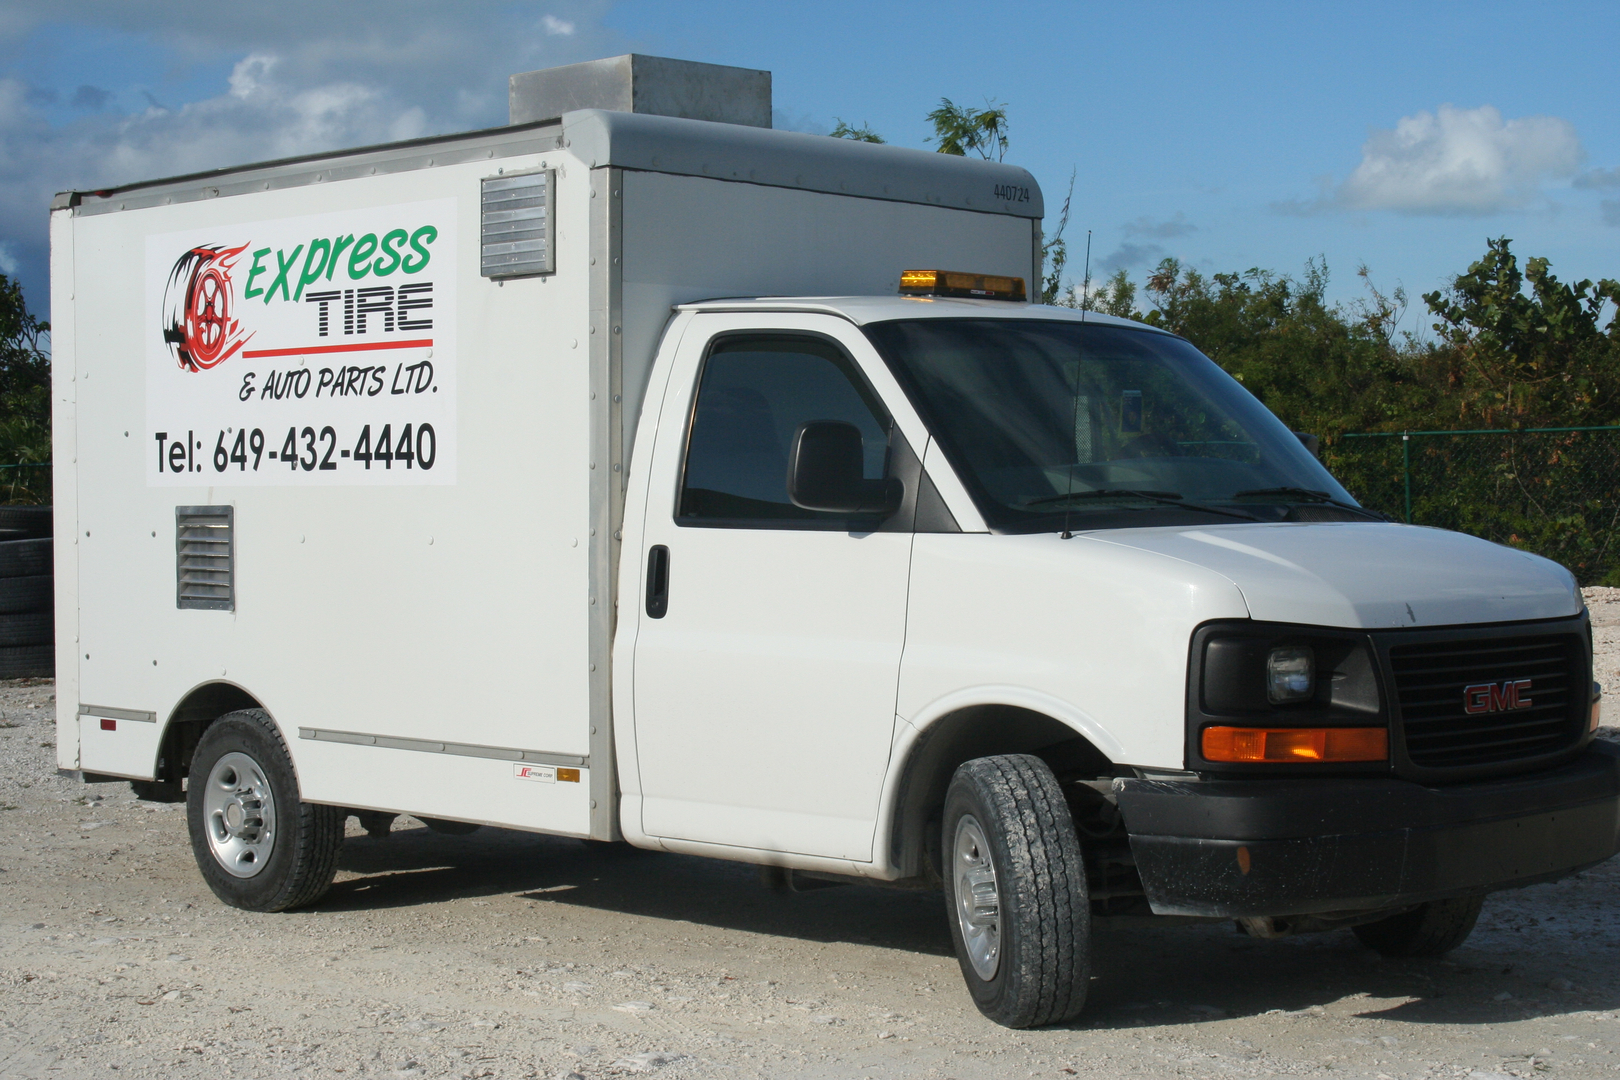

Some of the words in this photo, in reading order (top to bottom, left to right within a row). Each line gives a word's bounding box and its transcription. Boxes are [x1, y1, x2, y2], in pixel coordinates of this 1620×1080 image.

[994, 184, 1030, 203] 440724
[305, 282, 434, 337] TIRE
[239, 372, 256, 401] &
[261, 368, 312, 400] AUTO
[316, 365, 386, 398] PARTS
[391, 360, 438, 395] LTD.
[155, 430, 202, 473] Tel:
[213, 422, 437, 472] 649-432-4440
[1463, 679, 1533, 714] GMC
